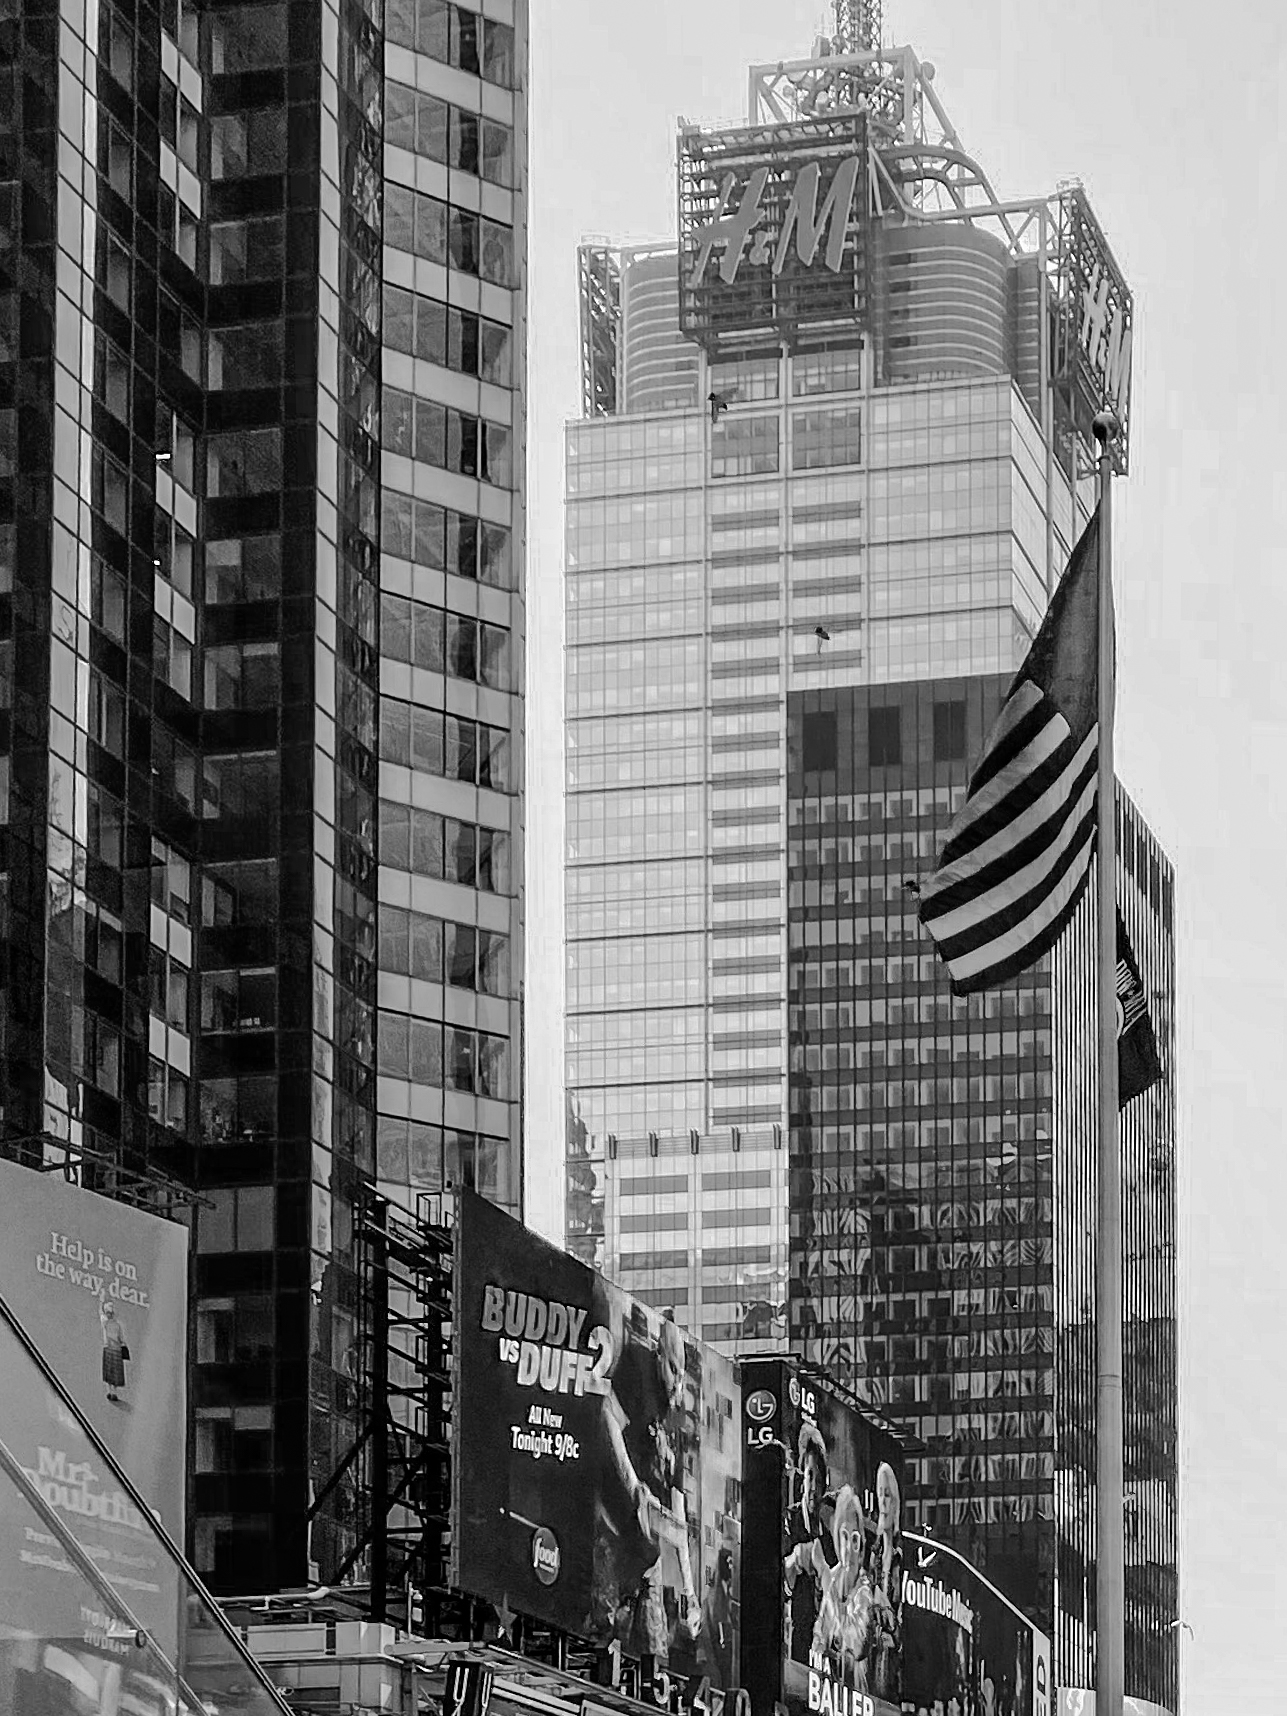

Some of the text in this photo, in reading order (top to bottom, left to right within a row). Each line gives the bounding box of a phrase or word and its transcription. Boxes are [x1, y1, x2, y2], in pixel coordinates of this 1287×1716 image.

[693, 157, 860, 285] H&M
[36, 1253, 150, 1308] the way, dear.
[50, 1232, 137, 1281] Help is on
[481, 1285, 588, 1350] BUDDY
[500, 1325, 614, 1396] VS DUFF 2
[801, 1387, 816, 1414] LG
[511, 1426, 553, 1459] Tonight
[747, 1427, 773, 1445] LG
[533, 1537, 559, 1568] food
